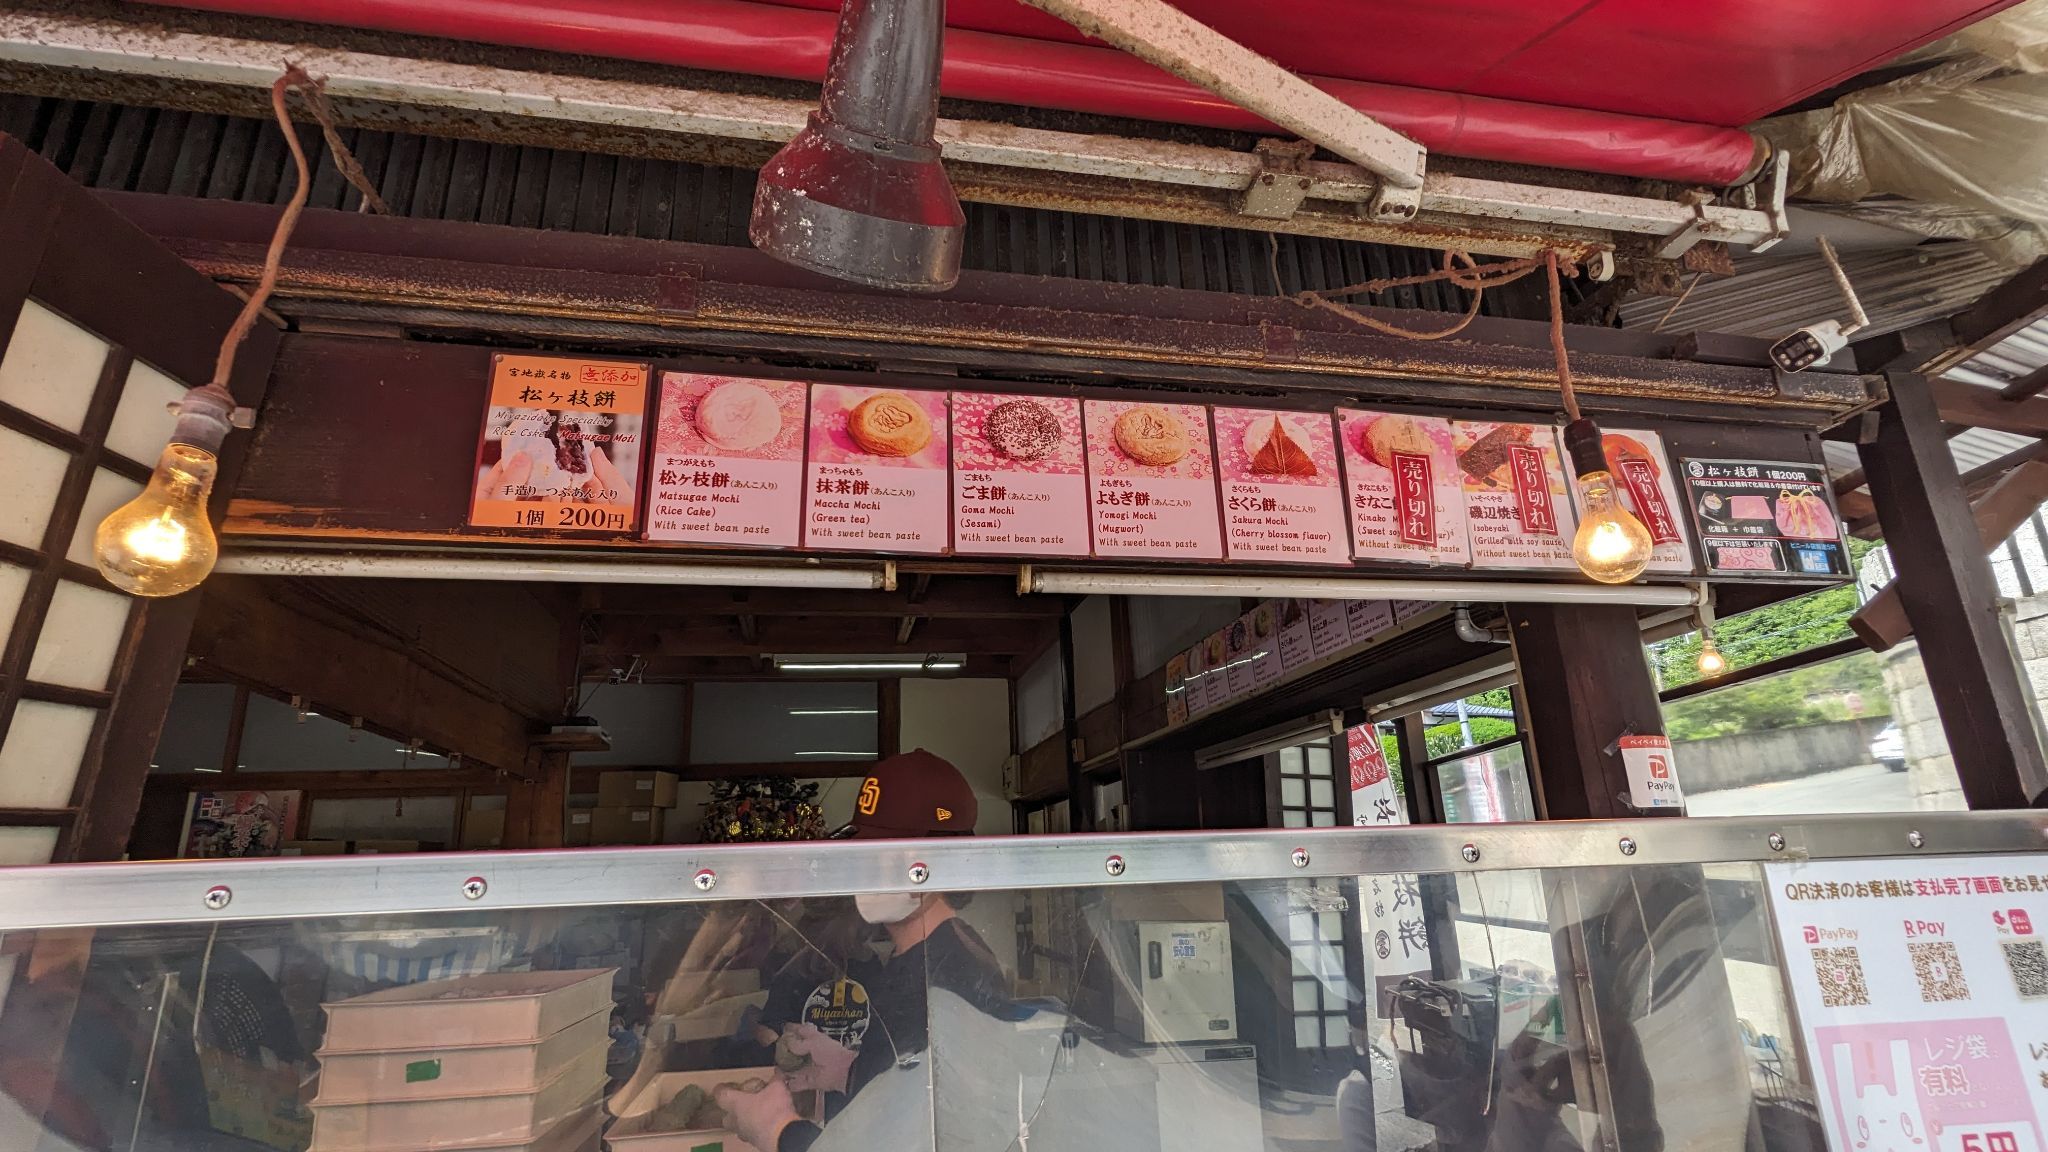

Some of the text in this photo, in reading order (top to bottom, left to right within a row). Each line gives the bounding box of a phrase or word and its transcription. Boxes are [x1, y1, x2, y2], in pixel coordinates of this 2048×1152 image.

[583, 367, 638, 382] 無添加
[492, 427, 517, 437] Rice
[559, 430, 611, 443] Matsugae
[611, 433, 637, 443] Moti
[666, 458, 716, 468] まつがえもち
[819, 466, 863, 476] まっちゃもち
[1766, 471, 1807, 482] 1個200円
[964, 473, 992, 482] ごまもち
[1100, 479, 1132, 488] よもぎもち
[1231, 485, 1261, 493] さくらもち
[1357, 483, 1389, 492] きなこもち
[1519, 452, 1548, 526] 売り切れ
[502, 485, 619, 500] 手造り つぶあん入り
[659, 491, 740, 504] Matsugae Mochi
[1402, 461, 1428, 536] 売り切れ
[1632, 465, 1673, 535] 売り切れ
[814, 499, 881, 510] Maccha Mochi
[961, 505, 1015, 515] Goma Mochi
[655, 504, 716, 518] (Rice Cake)
[1099, 510, 1157, 520] Yomogi Mochi
[515, 507, 625, 529] 1個 200円
[811, 512, 871, 525] (Green tea)
[1232, 515, 1289, 525] Sakura Mochi
[1357, 513, 1386, 523] Kinako
[654, 520, 770, 535] With sweet bean paste
[960, 519, 1001, 529] (Sesami)
[1098, 523, 1144, 534] (Mugwort)
[1473, 524, 1510, 532] Isobeyaki
[811, 527, 921, 541] With sweet bean paste
[1231, 528, 1265, 539] (Cherry
[1267, 530, 1299, 539] blossom
[1357, 526, 1386, 536] (Sweet
[960, 533, 1064, 545] With sweet bean paste
[1099, 538, 1198, 548] With sweet bean paste
[1474, 536, 1504, 546] (Grilled
[1507, 537, 1524, 545] with
[1526, 539, 1539, 547] soy
[1232, 542, 1327, 554] With sweet bean paste
[1358, 540, 1389, 549] Without
[1440, 544, 1460, 553] paste
[1476, 550, 1506, 558] Without
[1532, 550, 1551, 559] bean
[1554, 551, 1573, 559] paste
[1647, 781, 1675, 793] PayPay
[1819, 928, 1858, 941] PayPay
[1924, 1034, 1991, 1061] レジ袋
[1919, 1064, 1969, 1096] 有料
